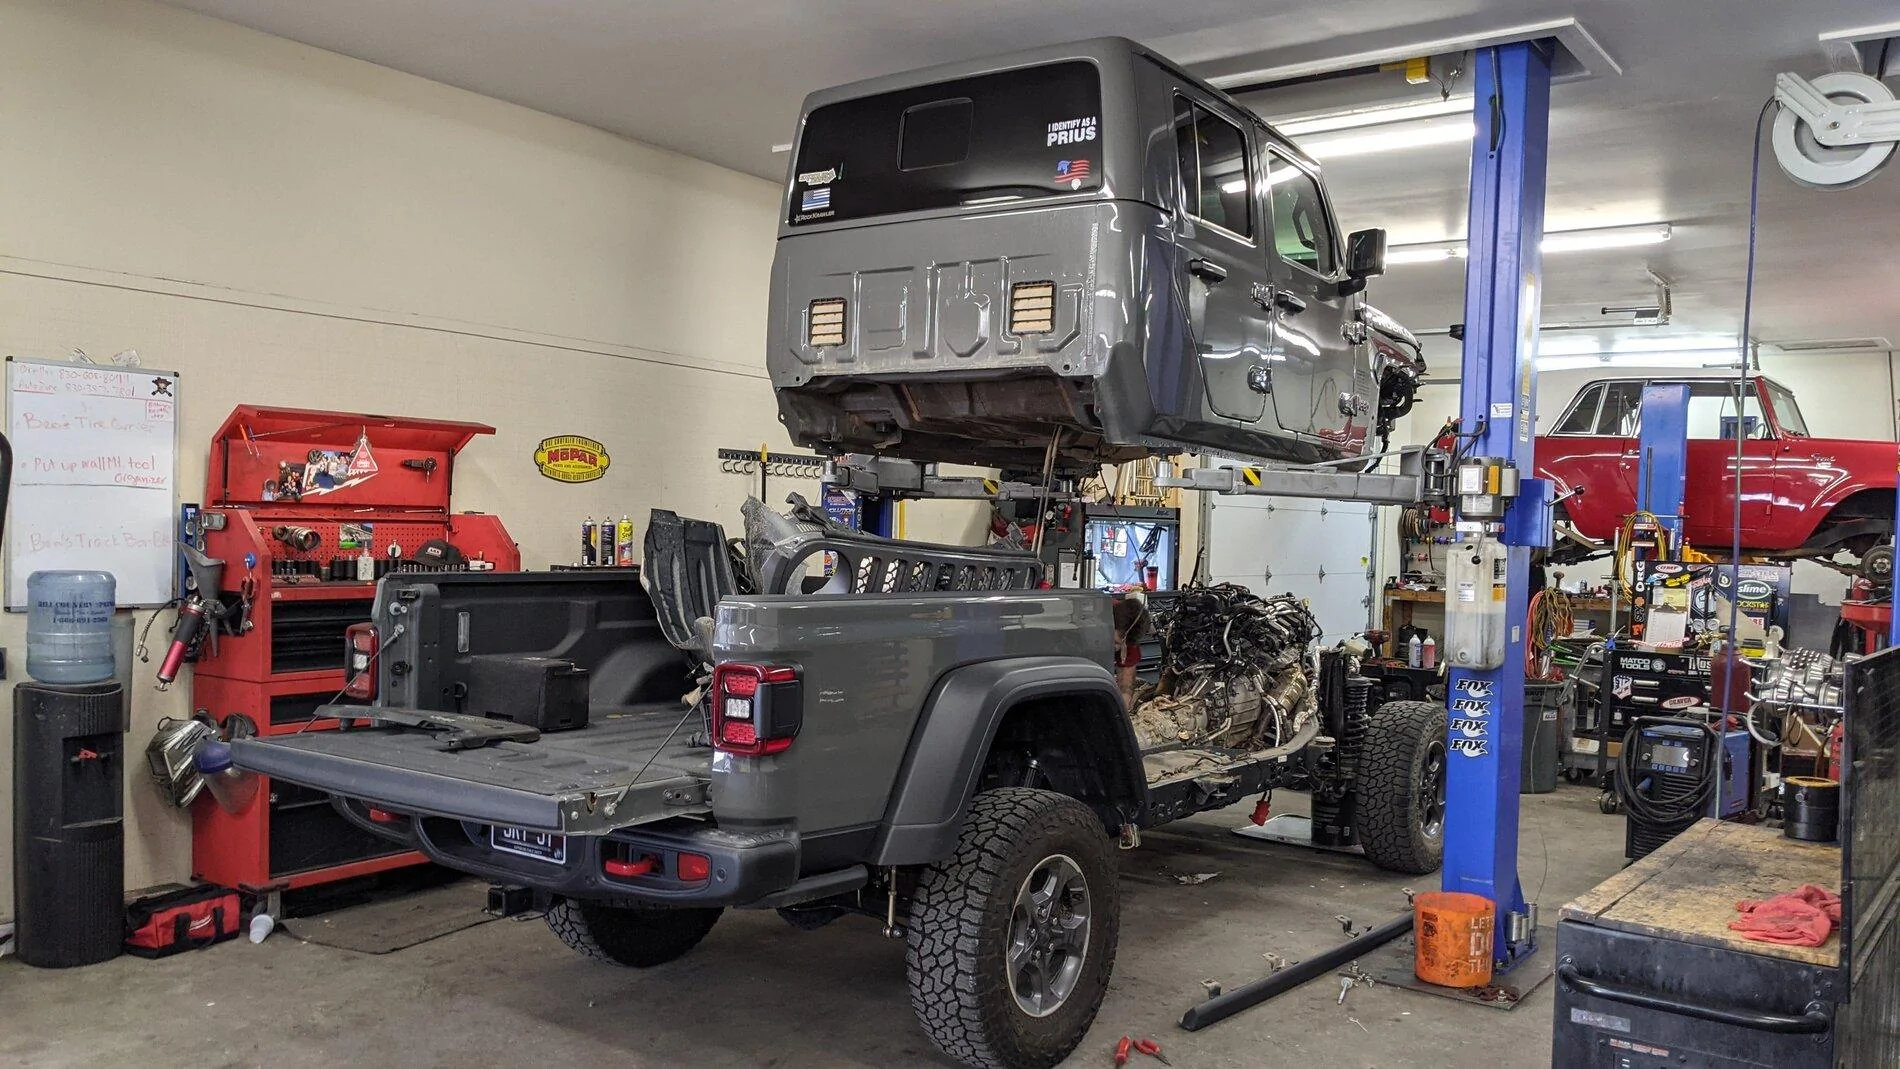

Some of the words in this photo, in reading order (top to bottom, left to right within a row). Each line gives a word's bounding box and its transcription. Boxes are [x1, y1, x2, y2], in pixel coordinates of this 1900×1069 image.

[1048, 123, 1051, 132] I
[1052, 119, 1081, 132] IDENTIFY
[1081, 117, 1090, 127] AS
[1091, 116, 1097, 126] A
[1047, 126, 1096, 147] PRIUS
[547, 447, 598, 467] MOPAR
[1738, 584, 1767, 594] slime
[1620, 657, 1650, 665] MATCO
[1621, 663, 1650, 671] TOOLS
[1456, 679, 1493, 693] FOX
[1453, 699, 1490, 713] FOX
[1450, 719, 1487, 733] FOX
[1450, 739, 1487, 753] FOX
